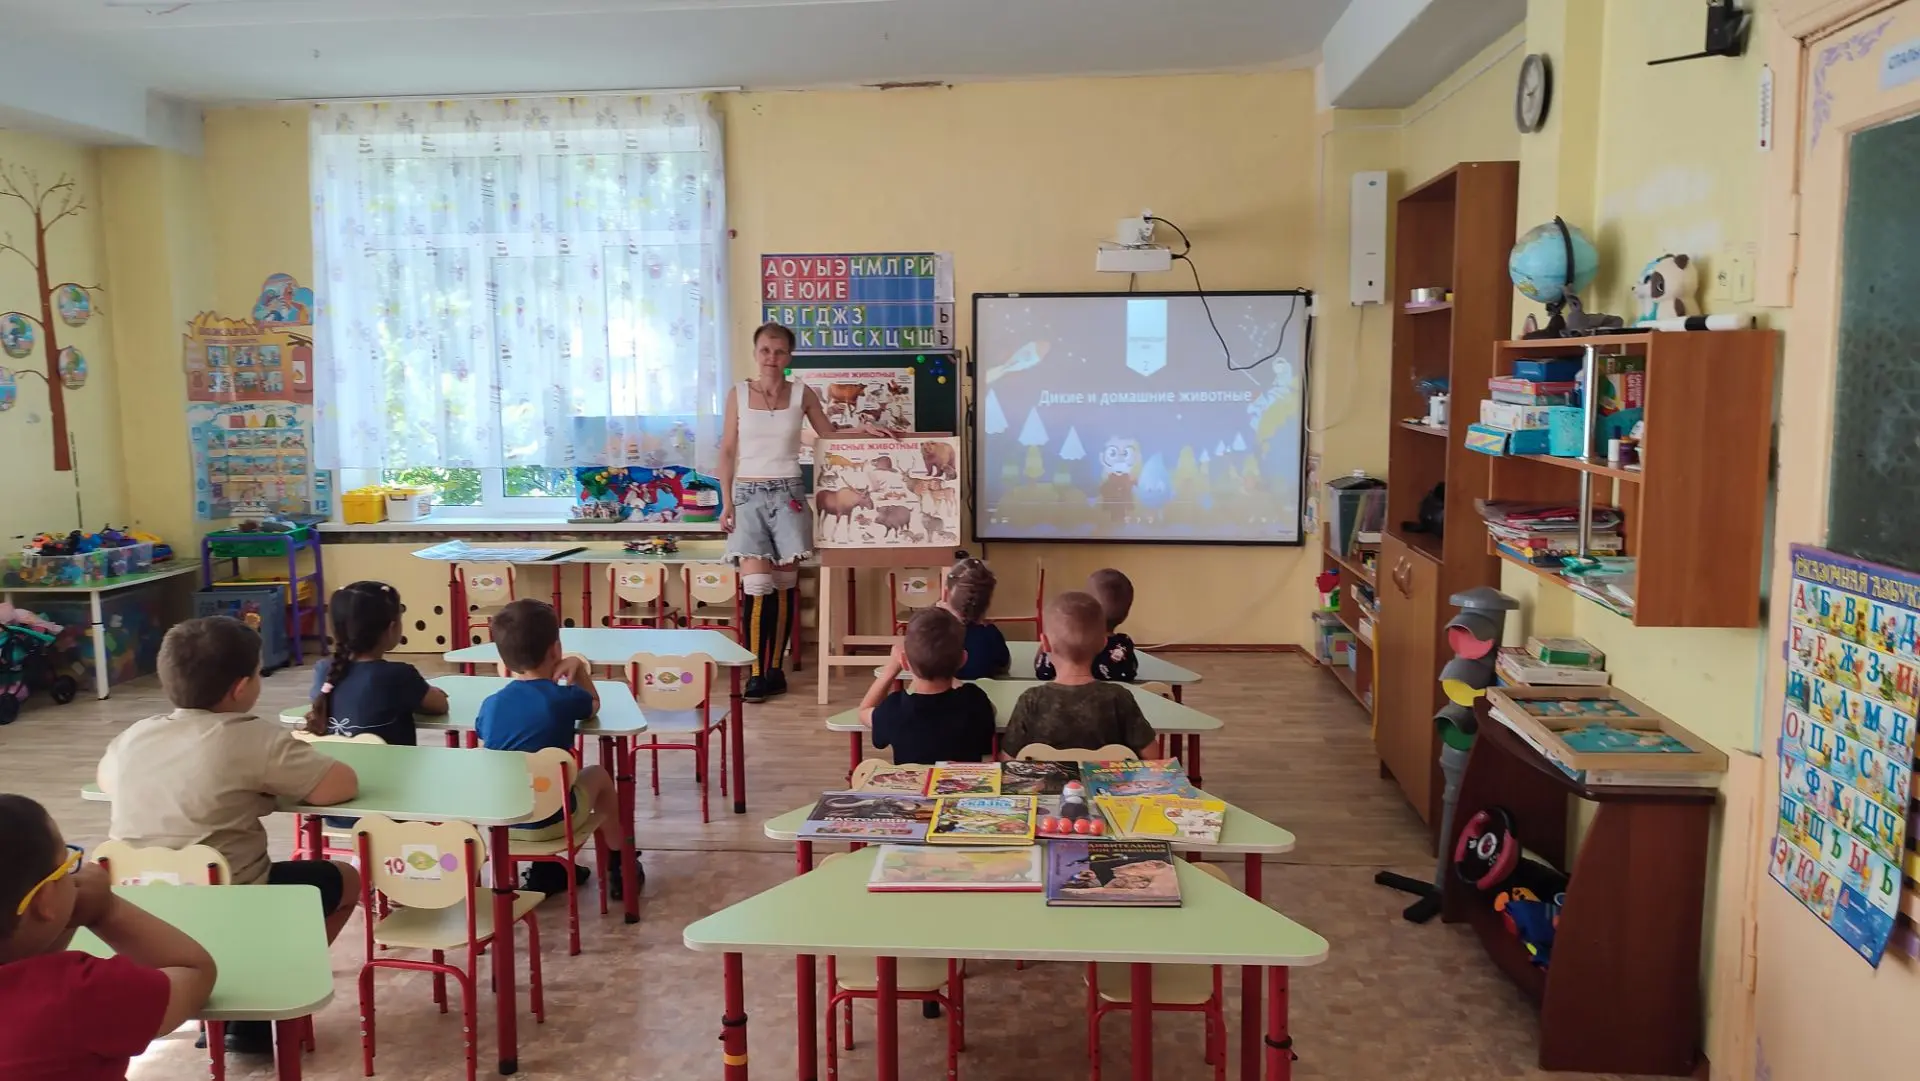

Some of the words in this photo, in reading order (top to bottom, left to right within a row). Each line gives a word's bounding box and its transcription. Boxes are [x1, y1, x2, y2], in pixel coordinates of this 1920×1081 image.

[1038, 390, 1084, 406] Дикие
[1088, 392, 1096, 403] и
[1099, 391, 1175, 406] домашние
[1179, 390, 1252, 402] животные
[830, 443, 865, 451] ЛЕСНЫЕ
[867, 442, 919, 450] ЖИВОТНЫЕ
[1795, 557, 1868, 594] СКАЗОЧНАЯ
[1795, 583, 1807, 609] А
[1820, 590, 1830, 616] Б
[1844, 597, 1856, 624] В
[1871, 604, 1884, 632] Г
[1899, 614, 1916, 650] Д
[1792, 626, 1802, 651] Е
[1840, 643, 1858, 672] Ж
[1866, 651, 1879, 682] З
[1895, 662, 1912, 697] И
[1812, 679, 1825, 708] К
[1834, 689, 1849, 720] Л
[1863, 700, 1882, 732] М
[1889, 712, 1908, 745] Н
[1786, 712, 1798, 738] О
[1809, 723, 1824, 753] П
[1835, 735, 1845, 762] Р
[1861, 749, 1873, 778] С
[1888, 761, 1900, 793] Т
[1784, 753, 1795, 779] У
[1806, 767, 1820, 795] Ф
[1831, 780, 1844, 811] Х
[1864, 800, 1879, 836] Ц
[1883, 811, 1896, 844] Ч
[385, 858, 405, 876] 10
[1777, 838, 1788, 865] Э
[1795, 854, 1814, 883] Ю
[1782, 796, 1796, 824] Ш
[1832, 829, 1842, 859] Ъ
[1848, 841, 1870, 875] Ы
[1880, 863, 1893, 896] Ь
